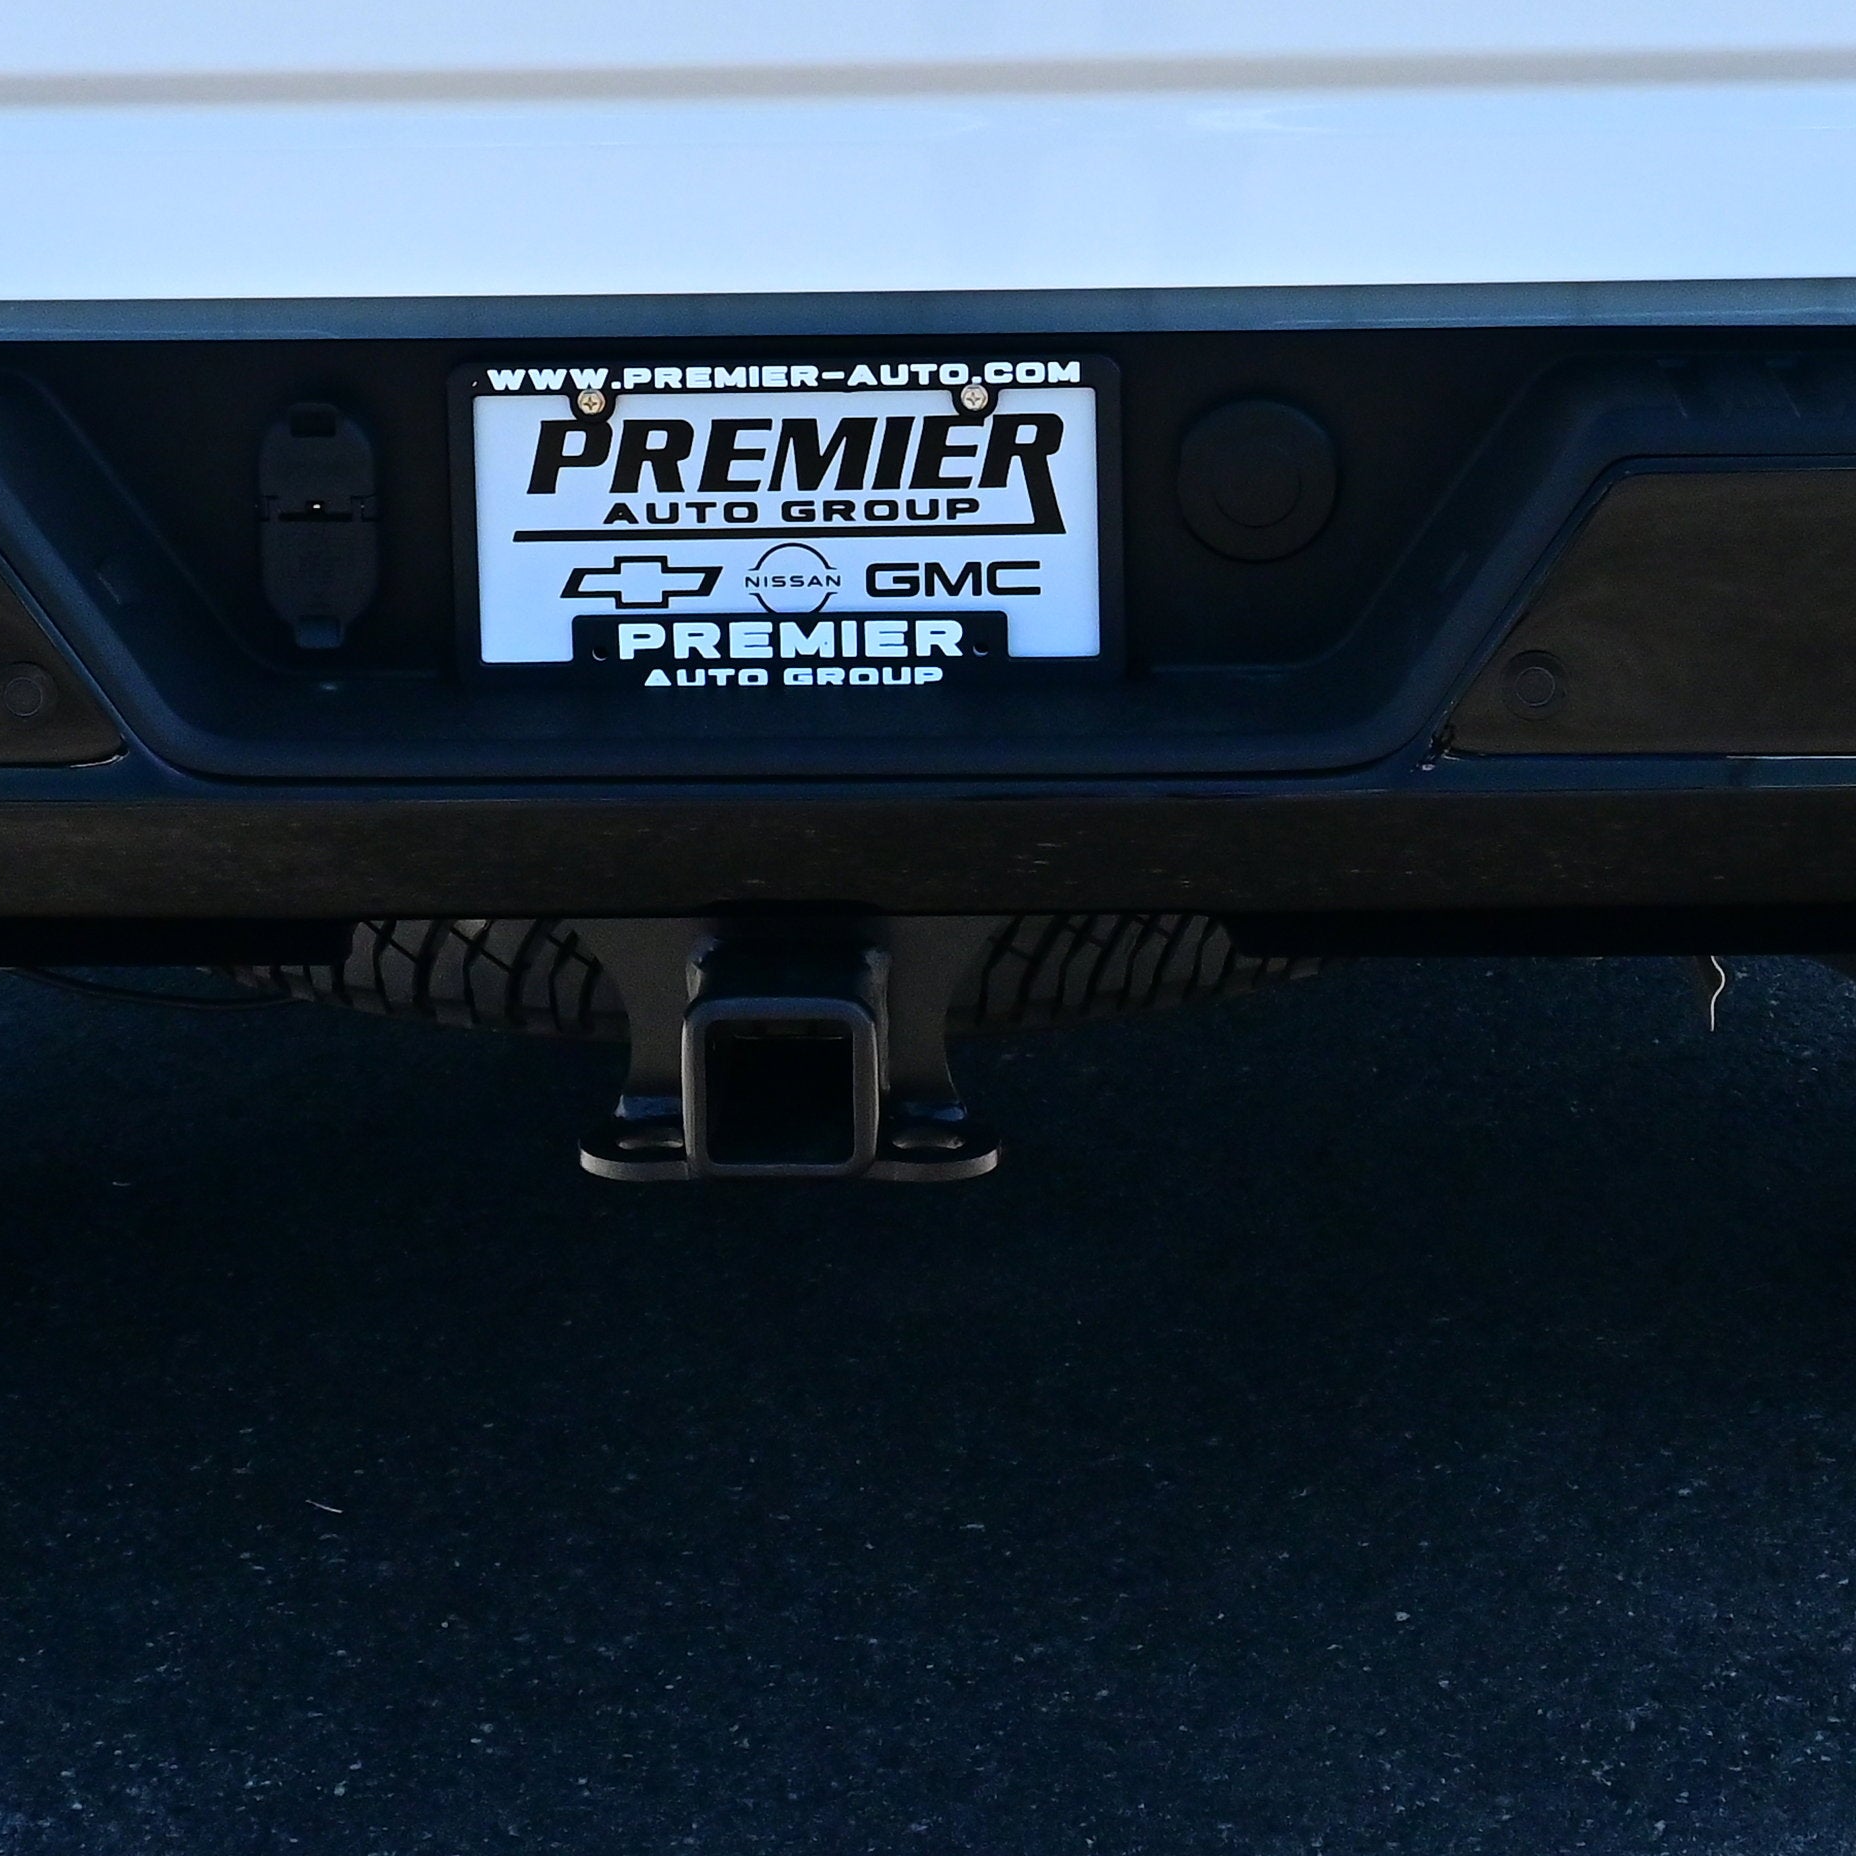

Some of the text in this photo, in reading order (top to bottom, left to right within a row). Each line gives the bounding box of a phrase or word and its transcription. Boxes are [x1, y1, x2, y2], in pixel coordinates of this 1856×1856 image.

[486, 361, 1082, 392] WWW.PREMIER-AUTO.COM
[526, 413, 1066, 534] PREMIER
[602, 497, 981, 526] AUTO GROUP
[744, 572, 842, 589] NISSAN
[865, 560, 1042, 598] GMC
[617, 619, 964, 661] PREMIER
[644, 666, 944, 687] AUTO GROUP
